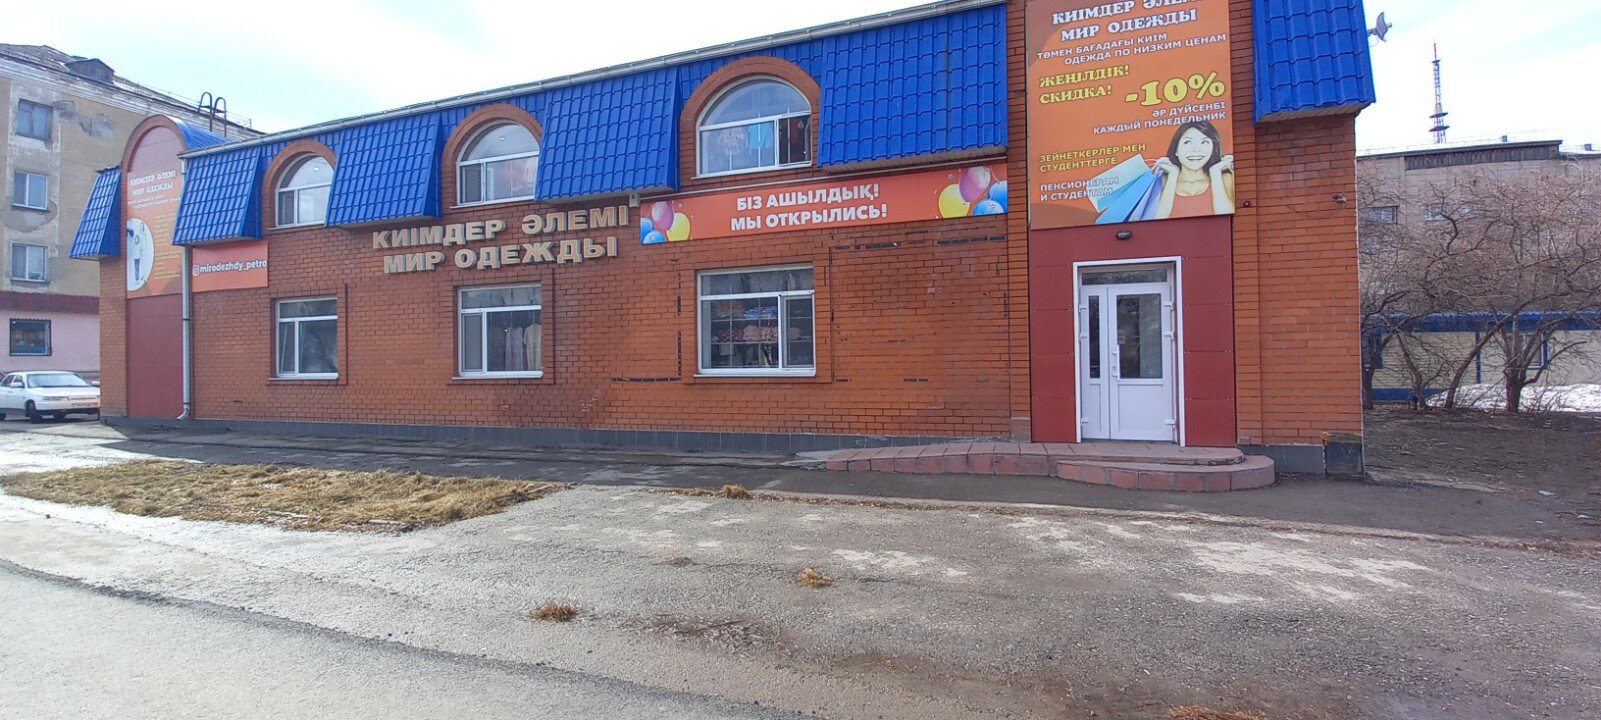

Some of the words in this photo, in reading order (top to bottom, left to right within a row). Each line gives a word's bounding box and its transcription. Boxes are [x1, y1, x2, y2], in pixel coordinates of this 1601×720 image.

[1052, 0, 1135, 25] КИІМДЕР
[1060, 25, 1100, 42] МИР
[1107, 9, 1197, 33] ОДЕЖДЫ
[1037, 48, 1073, 60] ТӨМЕН
[1076, 38, 1134, 54] БАҒАДАҒЫ
[1137, 33, 1168, 44] КИІМ
[1064, 51, 1111, 65] ОДЕЖДА
[1115, 48, 1130, 57] ПО
[1133, 40, 1181, 55] НИЗКИМ
[1185, 33, 1226, 47] ЦЕНАМ
[1039, 65, 1129, 88] ЖЕҢІЛДІК!
[1124, 71, 1226, 106] -10%
[1039, 84, 1112, 104] СКИДКА!
[1152, 109, 1167, 118] ӘР
[1169, 101, 1226, 116] ДҮЙСЕНБІ
[1093, 120, 1142, 135] КАЖДЫЙ
[1144, 111, 1226, 128] ПОНЕДЕЛЬНИК
[1039, 146, 1119, 163] ЗЕЙНЕТКЕРЛЕР
[1123, 143, 1146, 153] МЕН
[1039, 157, 1117, 173] СТУДЕНТТЕРГЕ
[736, 196, 762, 211] БІЗ
[766, 183, 879, 208] АШЫЛДЫҚ!
[1040, 193, 1048, 202] И
[1050, 187, 1114, 200] СТУДЕНТАМ
[372, 219, 507, 249] КИІМДЕР
[522, 205, 629, 235] ӘЛЕМІ
[731, 215, 762, 231] МЫ
[765, 203, 888, 228] ОТКРЫЛИСЬ!
[383, 251, 445, 274] МИР
[454, 236, 618, 269] ОДЕЖДЫ
